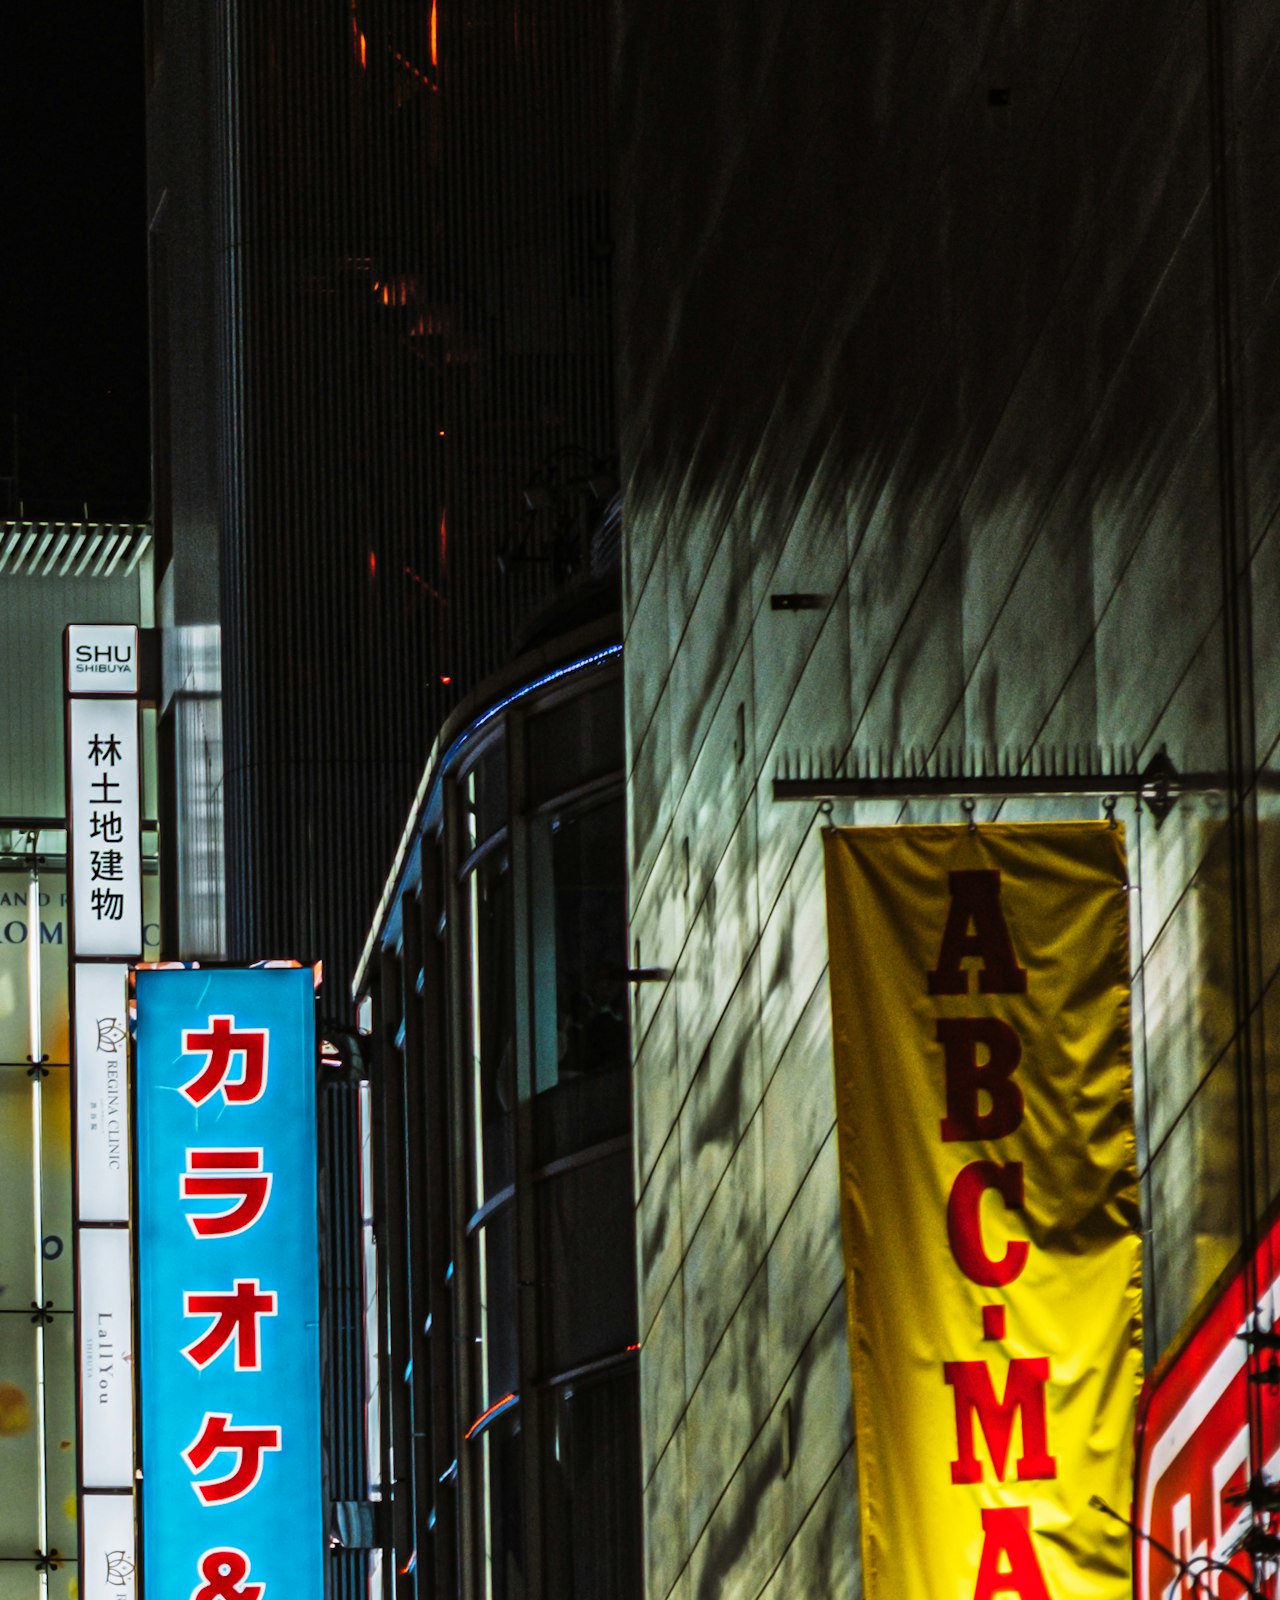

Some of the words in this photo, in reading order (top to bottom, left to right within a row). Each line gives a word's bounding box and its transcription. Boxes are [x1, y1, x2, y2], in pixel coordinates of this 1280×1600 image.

[75, 645, 132, 663] SHU
[75, 664, 132, 673] SHIBUYA
[87, 733, 125, 921] 林土地建物
[107, 1060, 119, 1115] REGINA
[108, 1120, 120, 1170] CLINIC
